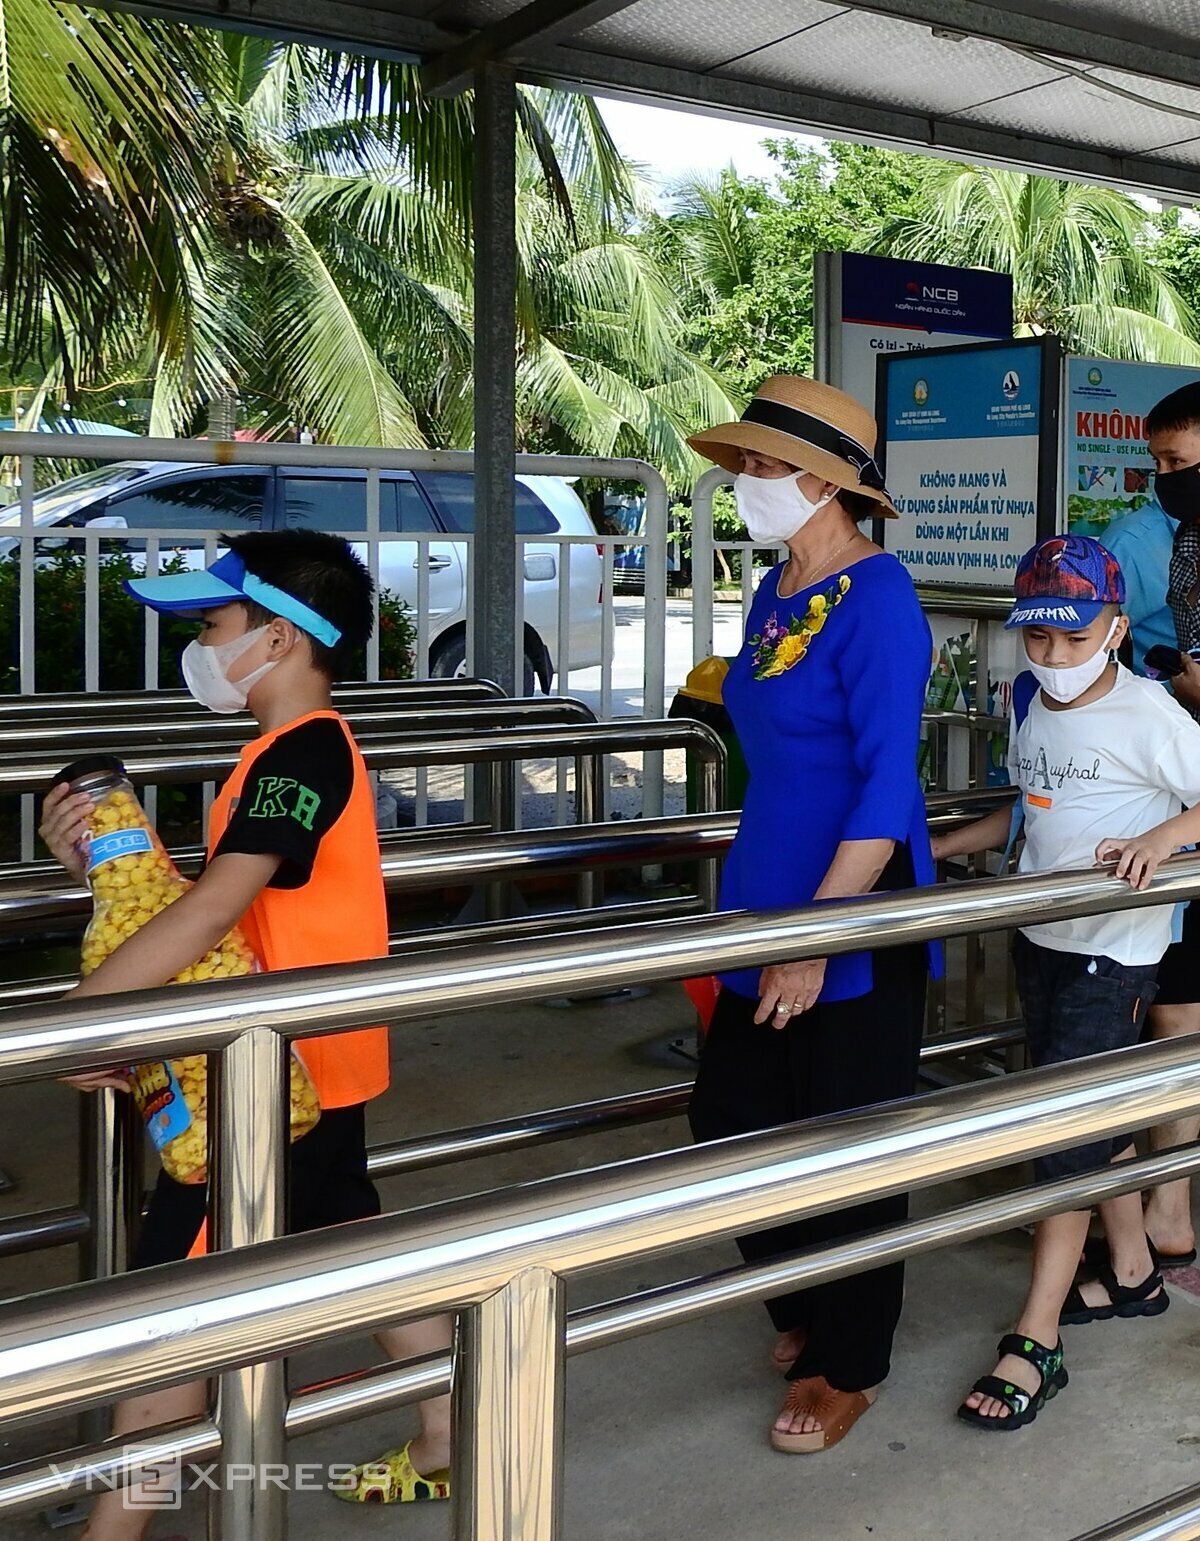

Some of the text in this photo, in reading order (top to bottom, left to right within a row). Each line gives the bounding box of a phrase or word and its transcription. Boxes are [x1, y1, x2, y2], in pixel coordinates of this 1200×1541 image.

[922, 286, 959, 302] NCB
[869, 339, 884, 350] Có
[1077, 443, 1087, 452] NO
[1088, 443, 1111, 454] SINGLE
[1117, 445, 1129, 455] USE
[920, 468, 1007, 488] KHÔNG MANG VÀ
[907, 499, 936, 516] DỤNG
[938, 494, 958, 514] SẢN
[960, 492, 989, 514] PHẨM
[991, 496, 1006, 514] TỪ
[1006, 500, 1035, 518] NHỰA
[916, 521, 944, 539] DÙNG
[946, 522, 968, 543] MỘT
[991, 527, 1009, 542] KHI
[896, 550, 924, 565] THAM
[925, 552, 955, 567] QUAN
[957, 553, 982, 570] VỊNH
[983, 554, 998, 571] HẠ
[248, 776, 321, 831] KR
